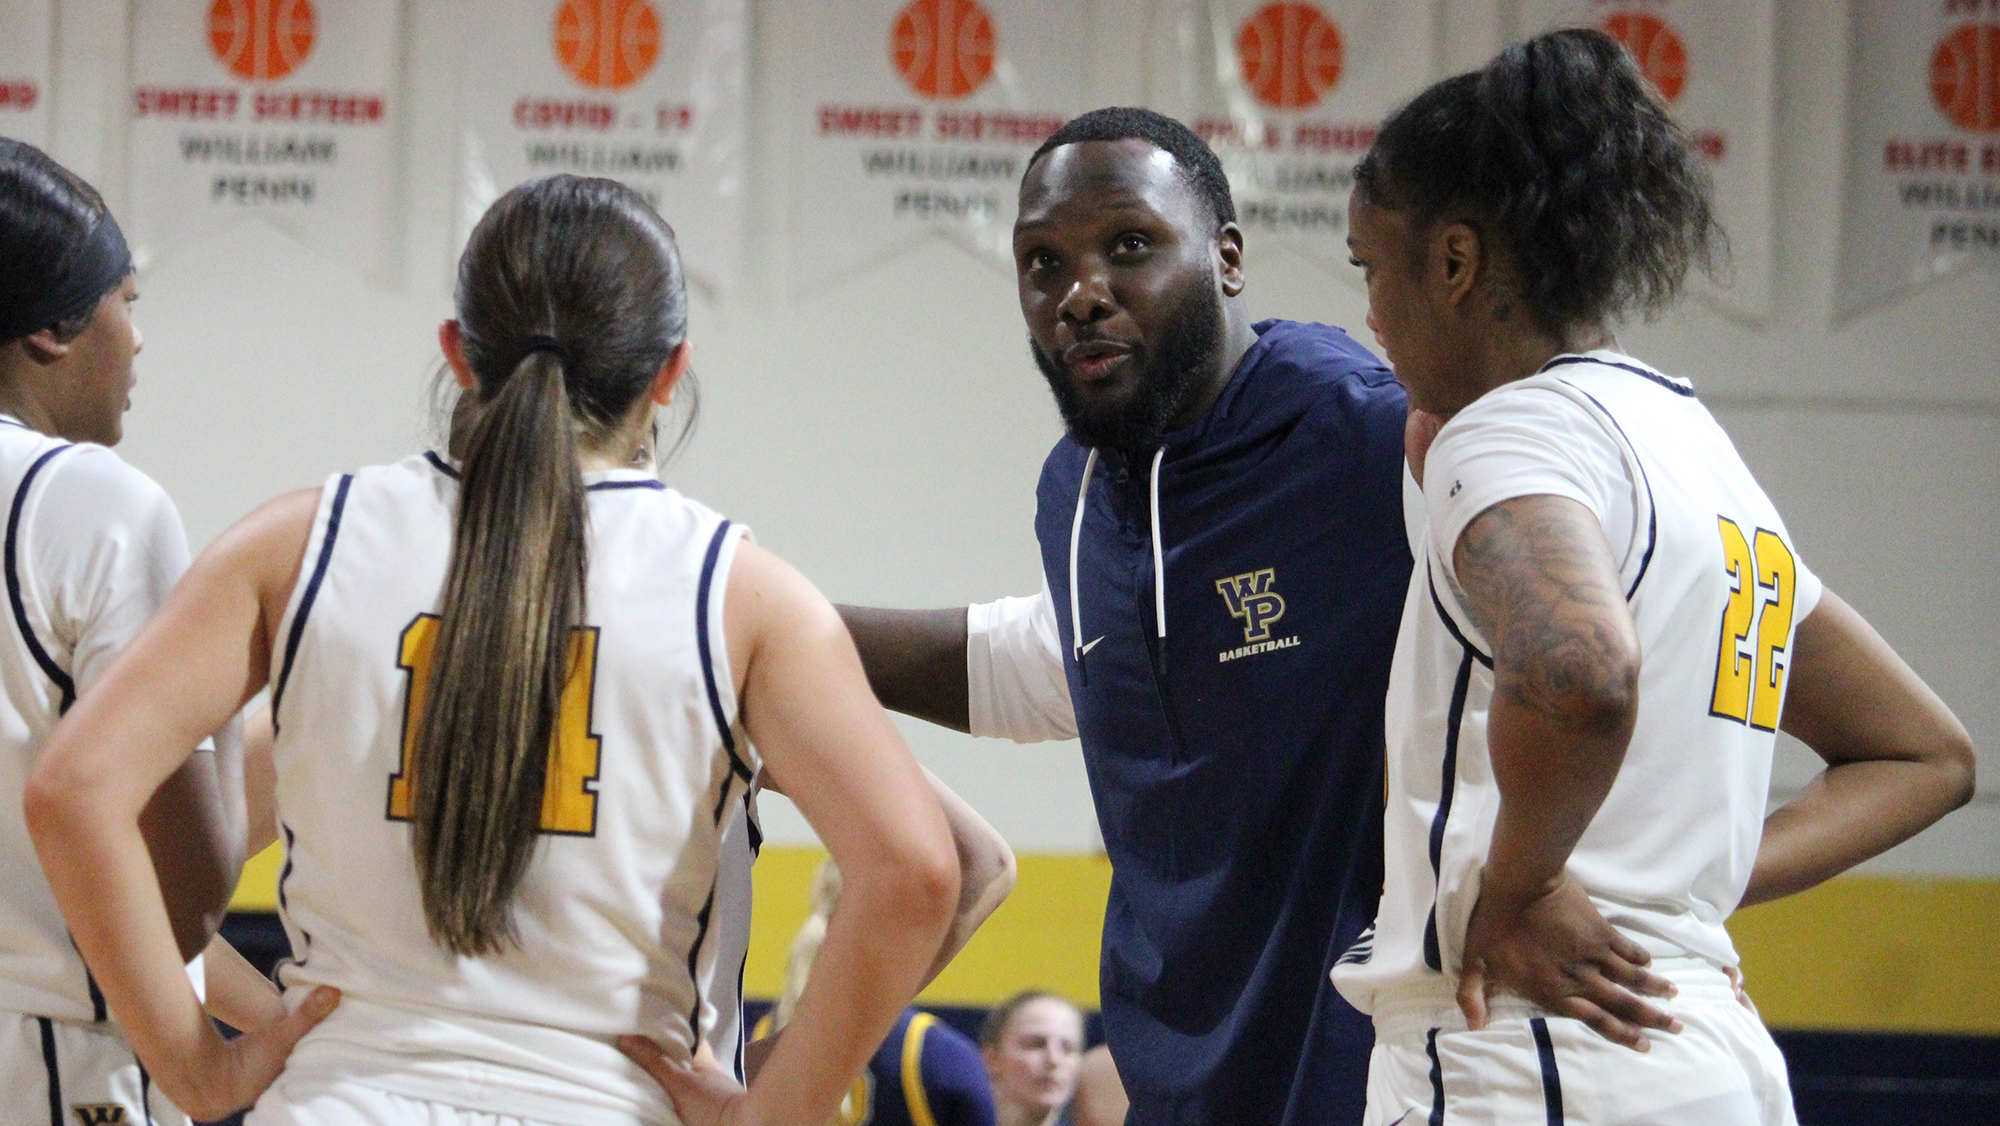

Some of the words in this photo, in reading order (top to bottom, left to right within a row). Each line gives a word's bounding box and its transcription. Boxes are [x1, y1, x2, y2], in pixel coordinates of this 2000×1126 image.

[134, 87, 239, 117] SWEET
[252, 92, 385, 123] SIXTEEN
[512, 99, 616, 131] COVID
[816, 106, 923, 138] SWEET
[179, 135, 336, 163] WILLIAM
[526, 143, 682, 172] WILLIAM
[1882, 143, 1969, 173] ELITE
[860, 151, 1018, 180] WILLIAM
[210, 176, 315, 205] PENN
[893, 188, 999, 219] PENN
[1900, 181, 2000, 210] WILLI
[1215, 567, 1286, 642] WP
[1708, 514, 1796, 734] 22
[1219, 635, 1301, 663] BASKETBALL
